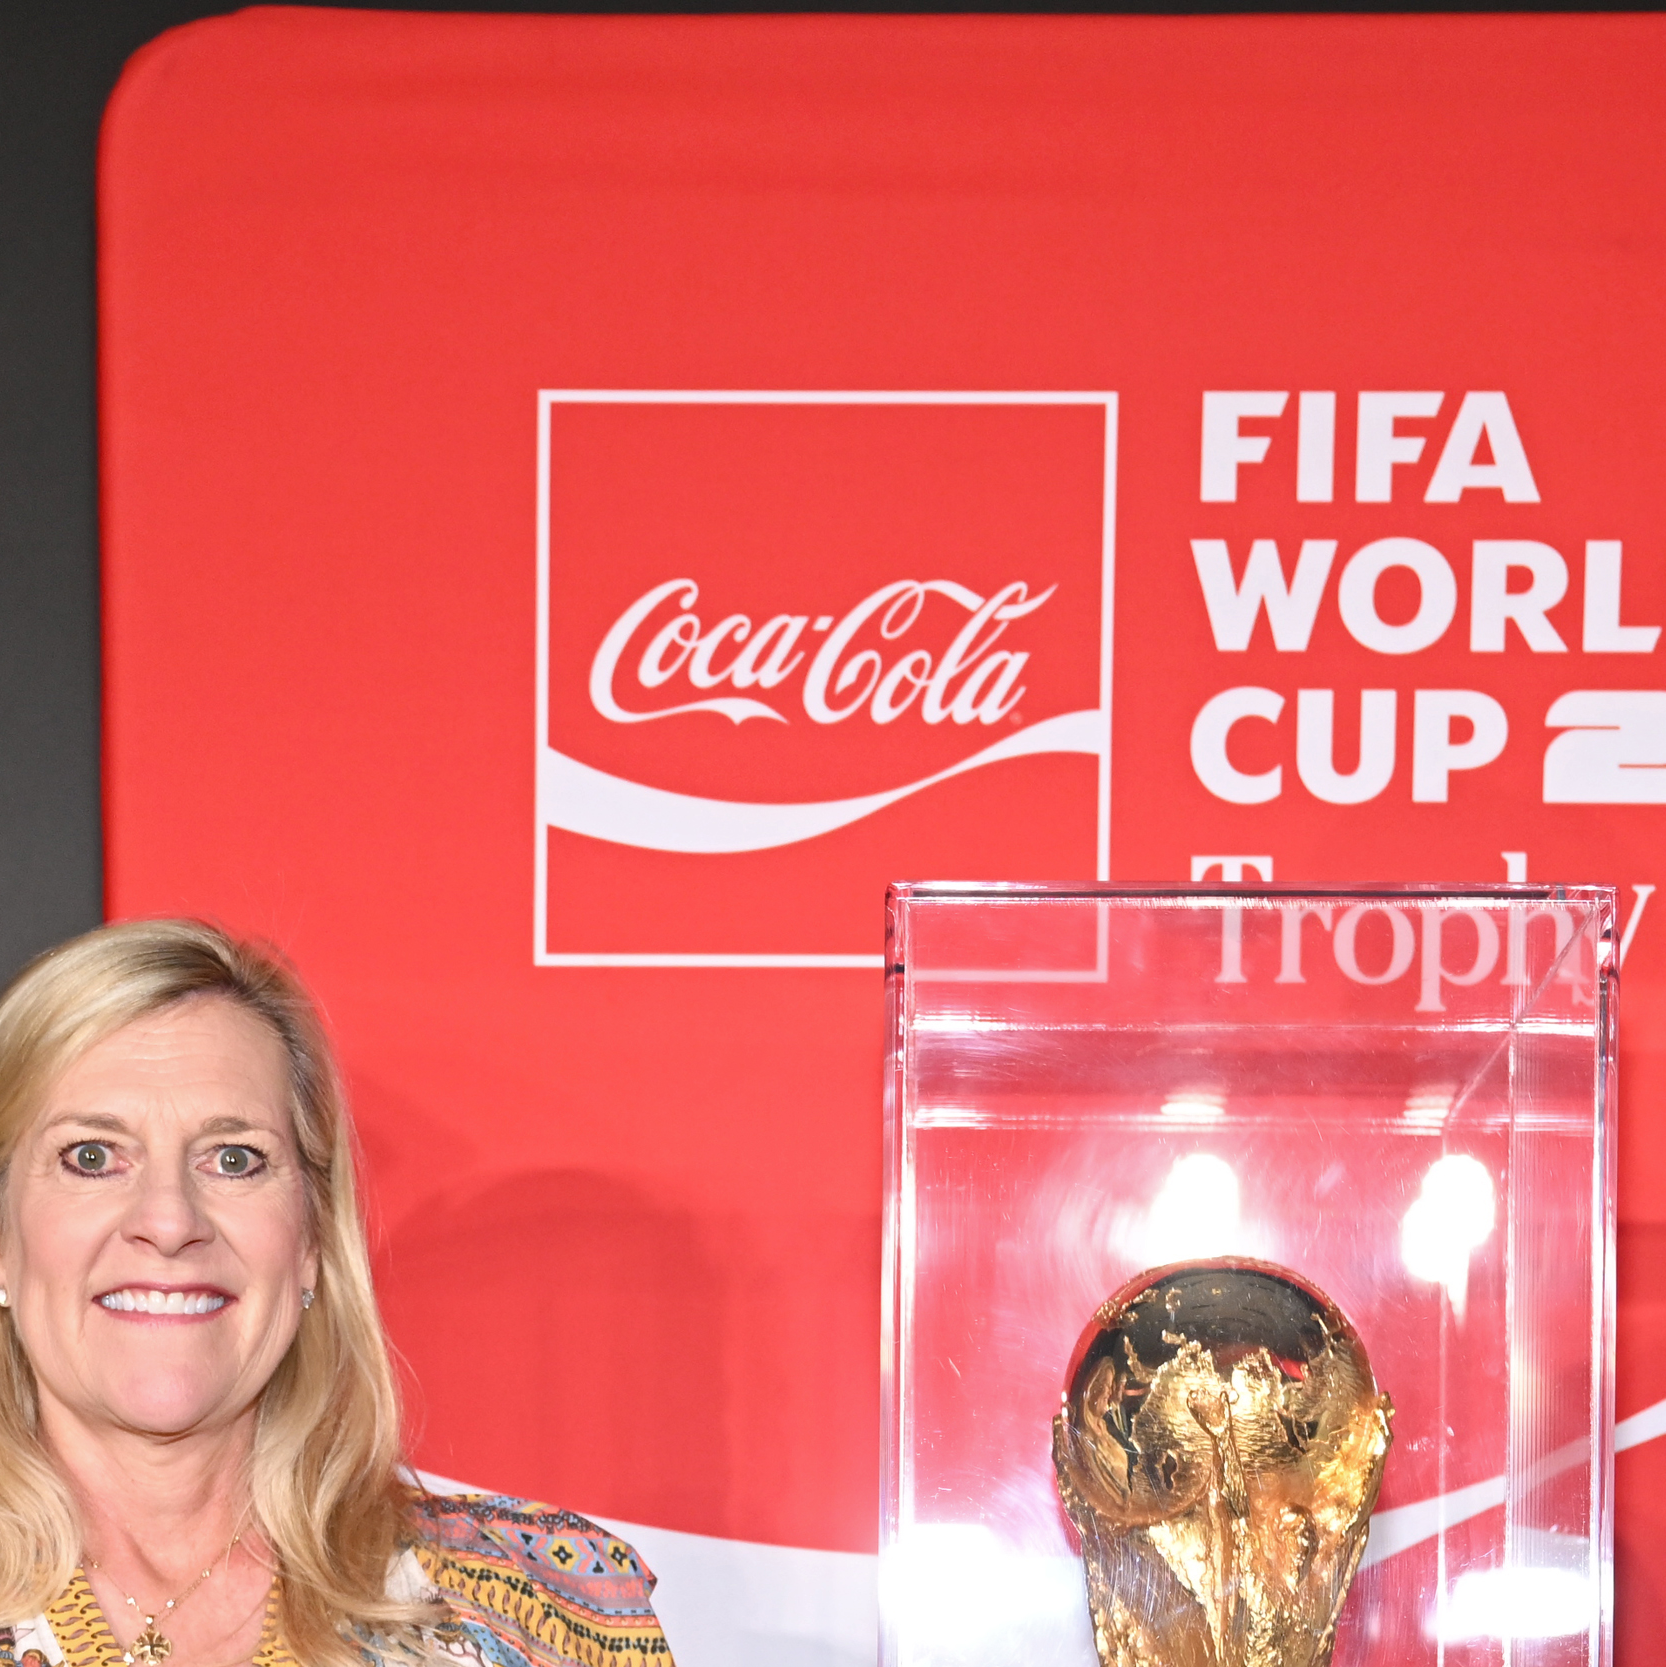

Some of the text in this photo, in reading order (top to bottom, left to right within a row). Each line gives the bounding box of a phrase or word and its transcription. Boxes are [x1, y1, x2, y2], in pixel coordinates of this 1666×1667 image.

[1201, 391, 1540, 502] FIFA
[590, 579, 1057, 724] Coca-Cola
[1191, 687, 1508, 804] CUP
[1190, 852, 1655, 1011] Trophy
